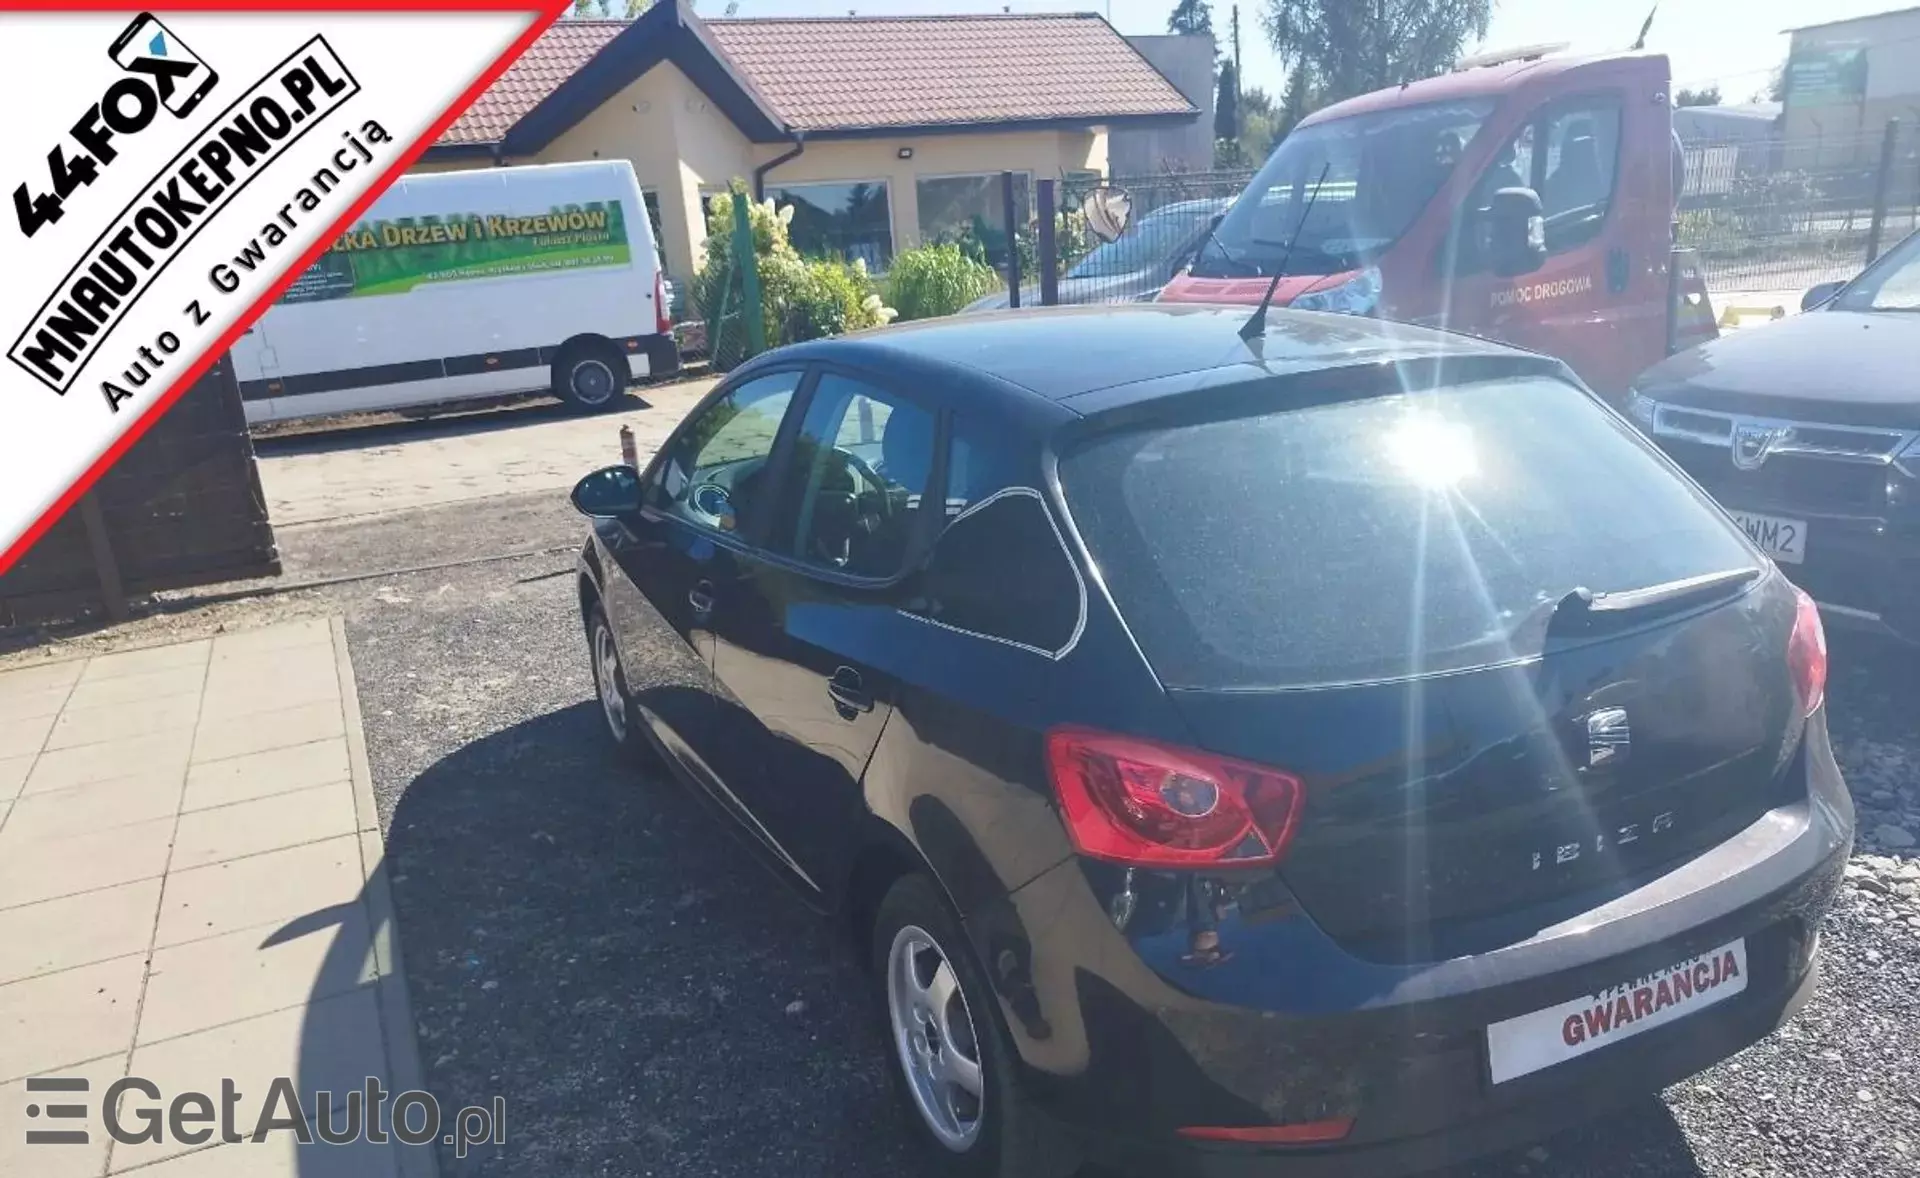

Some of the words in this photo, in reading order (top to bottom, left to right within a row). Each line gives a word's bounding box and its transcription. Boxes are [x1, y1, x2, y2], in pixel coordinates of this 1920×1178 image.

[382, 222, 468, 248] DRZEW
[487, 207, 606, 238] KRZEWÓW
[1490, 285, 1532, 308] POMOC
[1534, 275, 1592, 299] DROGOWA
[1737, 516, 1796, 552] WM2
[1532, 811, 1673, 870] IBIZA
[1562, 949, 1741, 1046] GWARANCJA
